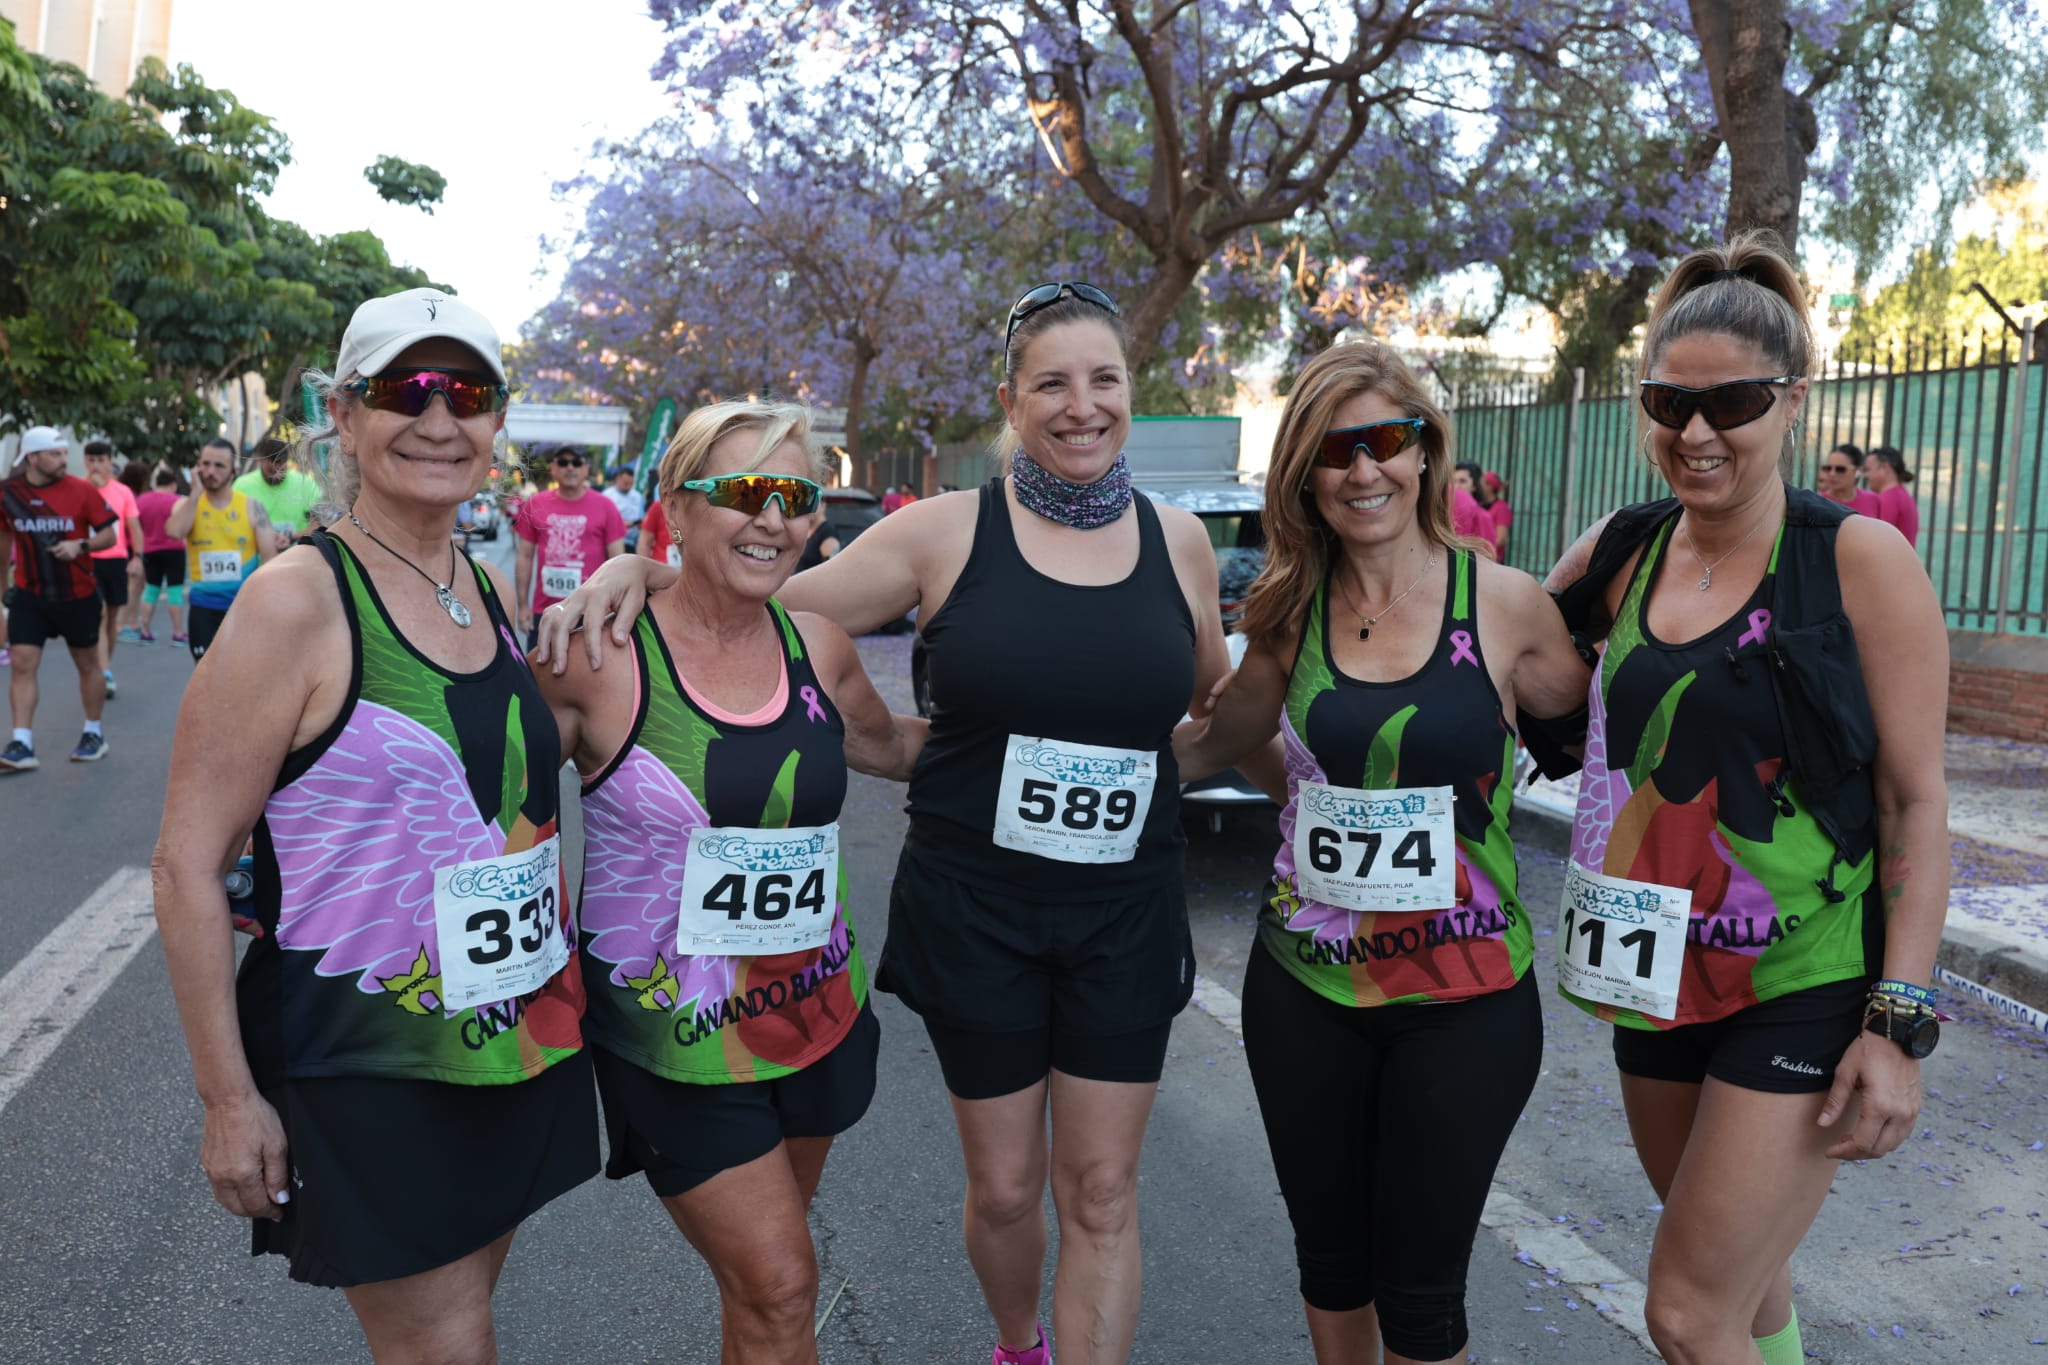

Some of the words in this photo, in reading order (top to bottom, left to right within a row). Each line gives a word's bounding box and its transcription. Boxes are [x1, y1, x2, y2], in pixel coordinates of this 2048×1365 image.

[14, 517, 75, 532] SARRIA
[204, 560, 237, 573] 394
[546, 576, 576, 590] 498
[1037, 748, 1121, 774] Carrera
[1055, 767, 1125, 787] Prensa
[1018, 778, 1136, 831] 589
[1319, 791, 1404, 815] Carrera
[1333, 811, 1413, 829] Prensa
[723, 836, 811, 857] Carrera
[1309, 827, 1436, 878] 674
[742, 853, 816, 871] Prensa
[702, 868, 825, 920] 464
[1638, 889, 1659, 901] de
[466, 886, 554, 965] 333
[784, 921, 796, 929] ANA
[1296, 926, 1419, 966] GANANDO
[1565, 907, 1656, 979] 111
[1605, 976, 1630, 987] MARINA
[674, 980, 787, 1047] GANANDO
[1771, 1055, 1824, 1076] Fashion
